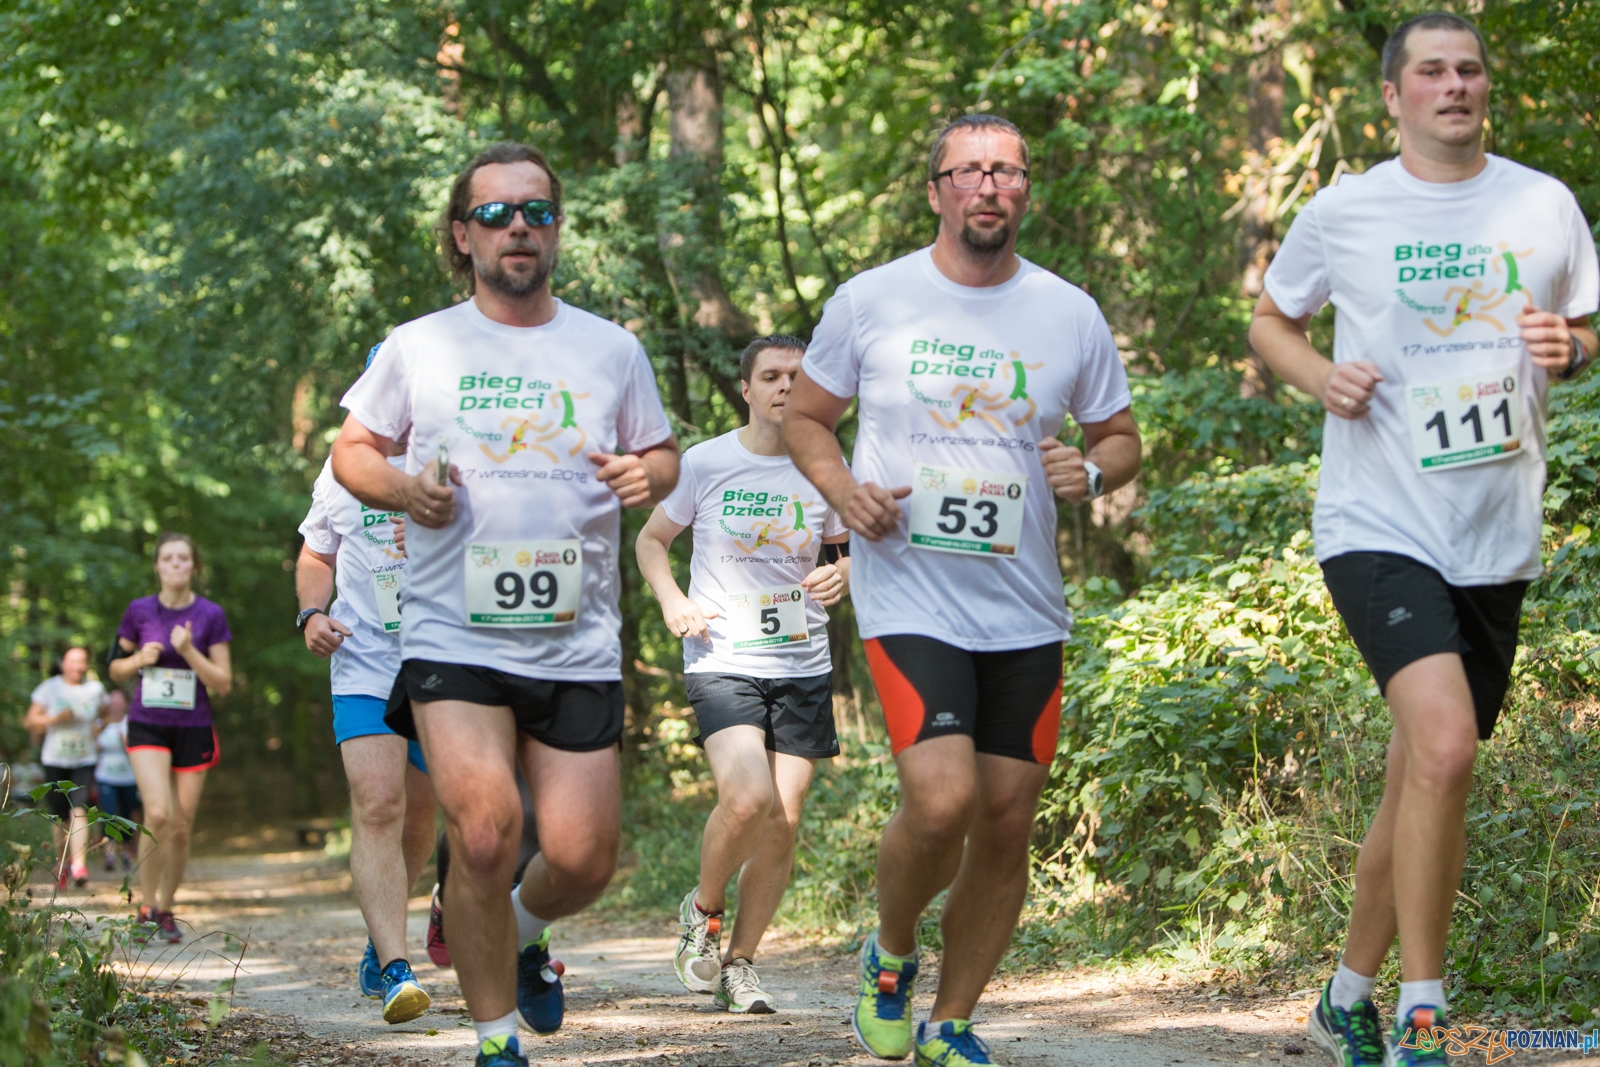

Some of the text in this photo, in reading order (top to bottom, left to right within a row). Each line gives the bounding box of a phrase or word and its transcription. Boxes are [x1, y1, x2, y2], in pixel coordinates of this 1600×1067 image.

[1394, 241, 1492, 262] Bieg dla
[1398, 259, 1486, 282] Dzieci
[910, 338, 1004, 361] Bieg dla
[1401, 344, 1422, 356] 17
[910, 360, 996, 378] Dzieci
[458, 372, 552, 392] Bieg dla
[460, 393, 544, 410] Dzieci
[1426, 398, 1512, 449] 111
[908, 434, 927, 444] 17
[550, 469, 588, 483] 2016
[722, 489, 768, 505] Bieg
[722, 504, 784, 517] Dzieci
[936, 496, 998, 538] 53
[720, 556, 734, 564] 17
[785, 556, 812, 564] 2016
[494, 570, 558, 610] 99
[760, 607, 780, 635] 5
[161, 680, 174, 698] 3
